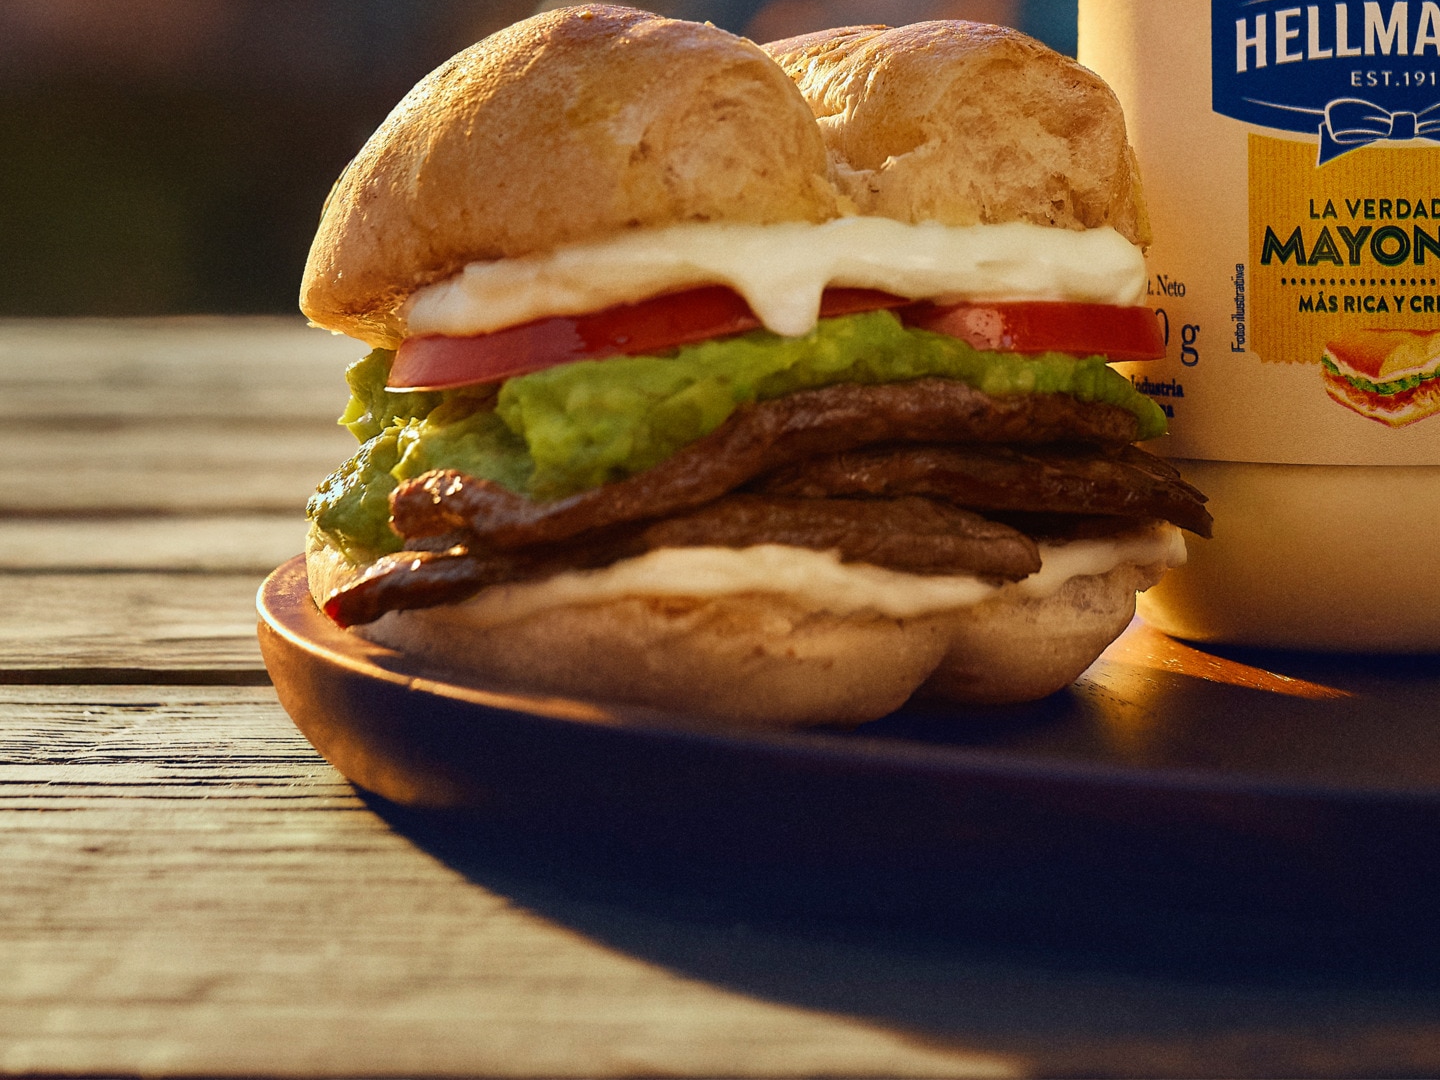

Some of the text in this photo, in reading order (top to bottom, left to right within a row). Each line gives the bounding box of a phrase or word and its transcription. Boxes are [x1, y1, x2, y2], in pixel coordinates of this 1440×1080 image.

[1309, 199, 1338, 219] LA
[1157, 274, 1186, 297] Neto
[1298, 291, 1338, 313] MÁS
[1344, 295, 1389, 312] RICA
[1393, 295, 1406, 312] Y
[1180, 323, 1200, 367] g
[1231, 322, 1246, 353] Foto
